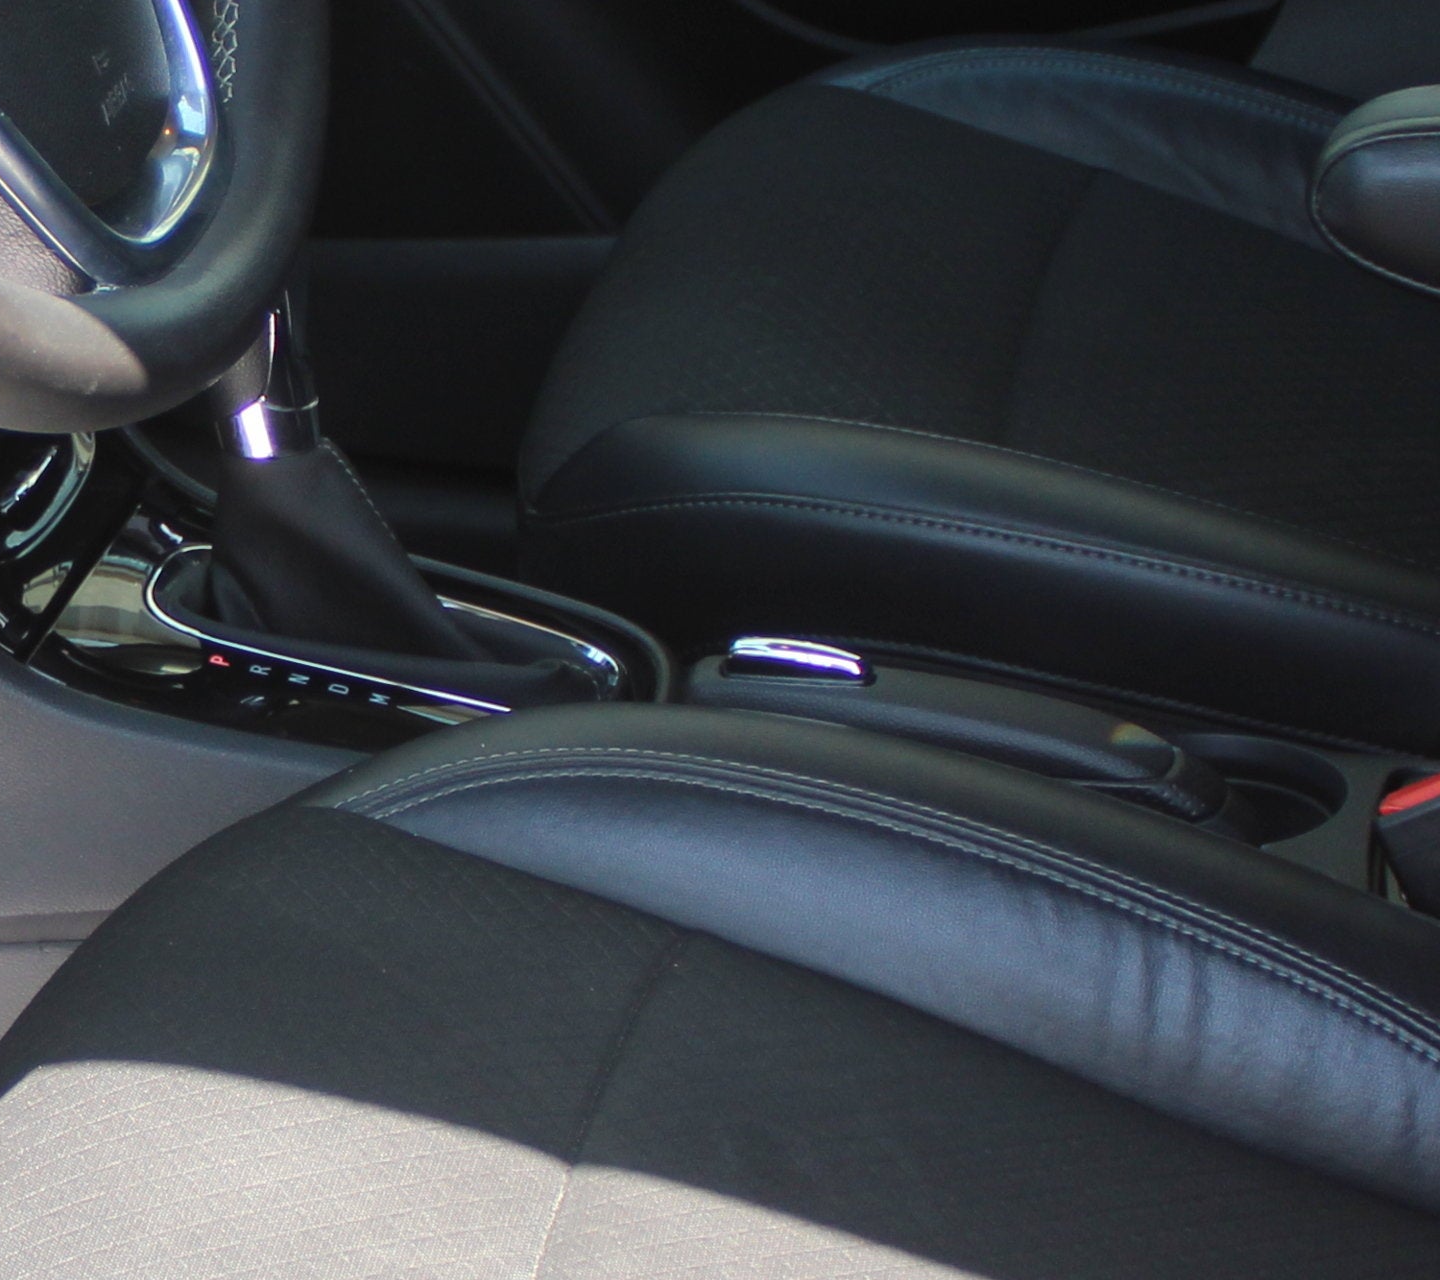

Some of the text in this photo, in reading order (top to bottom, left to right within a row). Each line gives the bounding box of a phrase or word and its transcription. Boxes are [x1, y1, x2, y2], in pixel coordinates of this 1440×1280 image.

[209, 654, 391, 705] P R N D M
